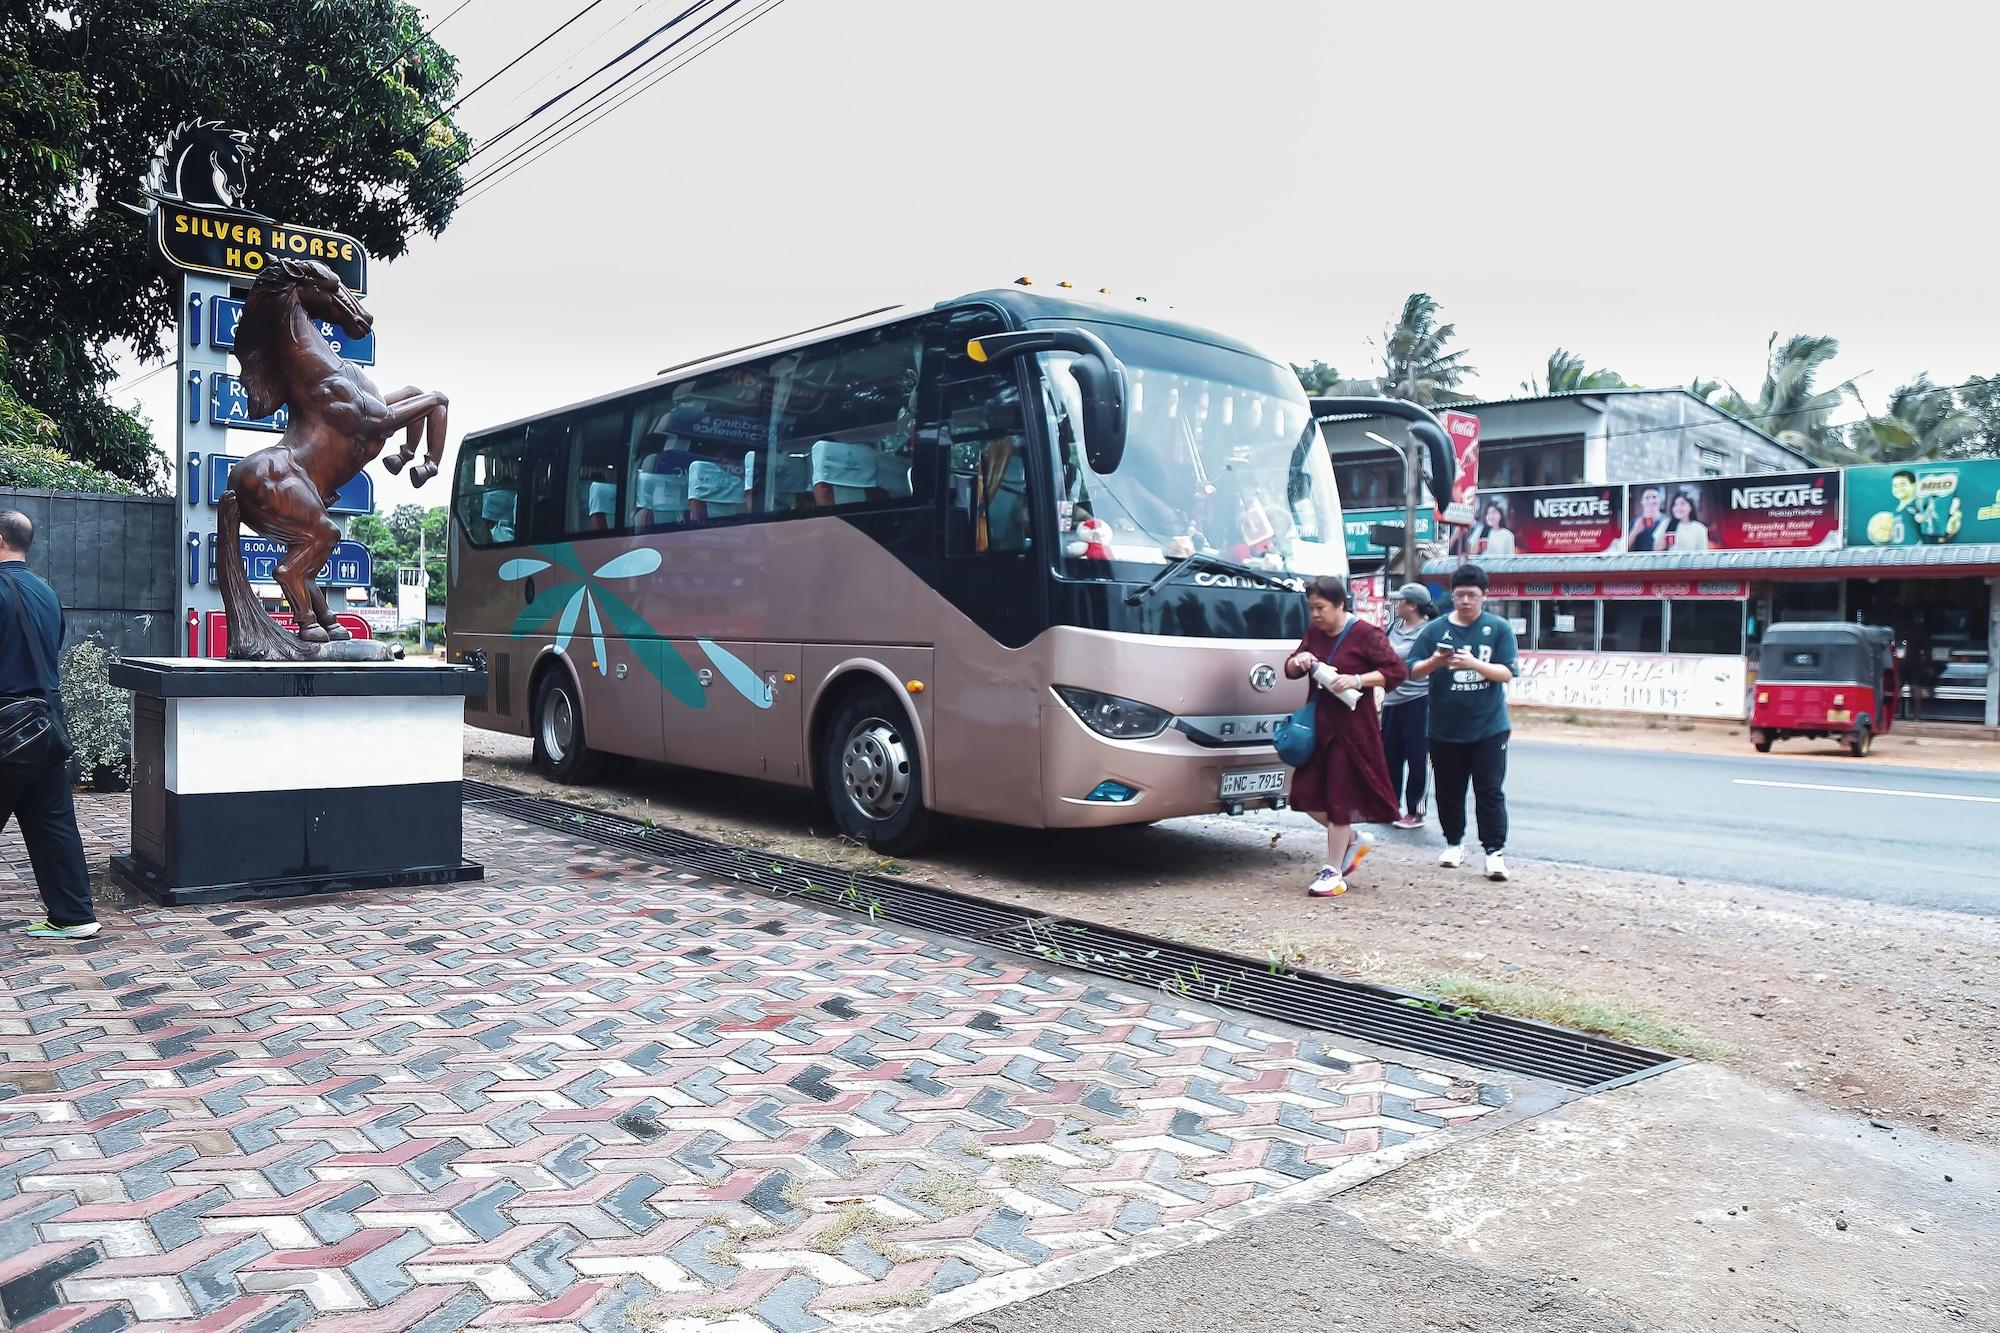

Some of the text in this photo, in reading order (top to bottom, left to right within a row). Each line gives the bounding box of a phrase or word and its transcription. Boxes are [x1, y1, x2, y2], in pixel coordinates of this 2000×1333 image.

[175, 214, 353, 262] SILVER HORSE
[244, 543, 264, 553] 8.00
[266, 544, 288, 553] A.M.
[1233, 775, 1248, 792] NC
[1258, 773, 1284, 789] 7915
